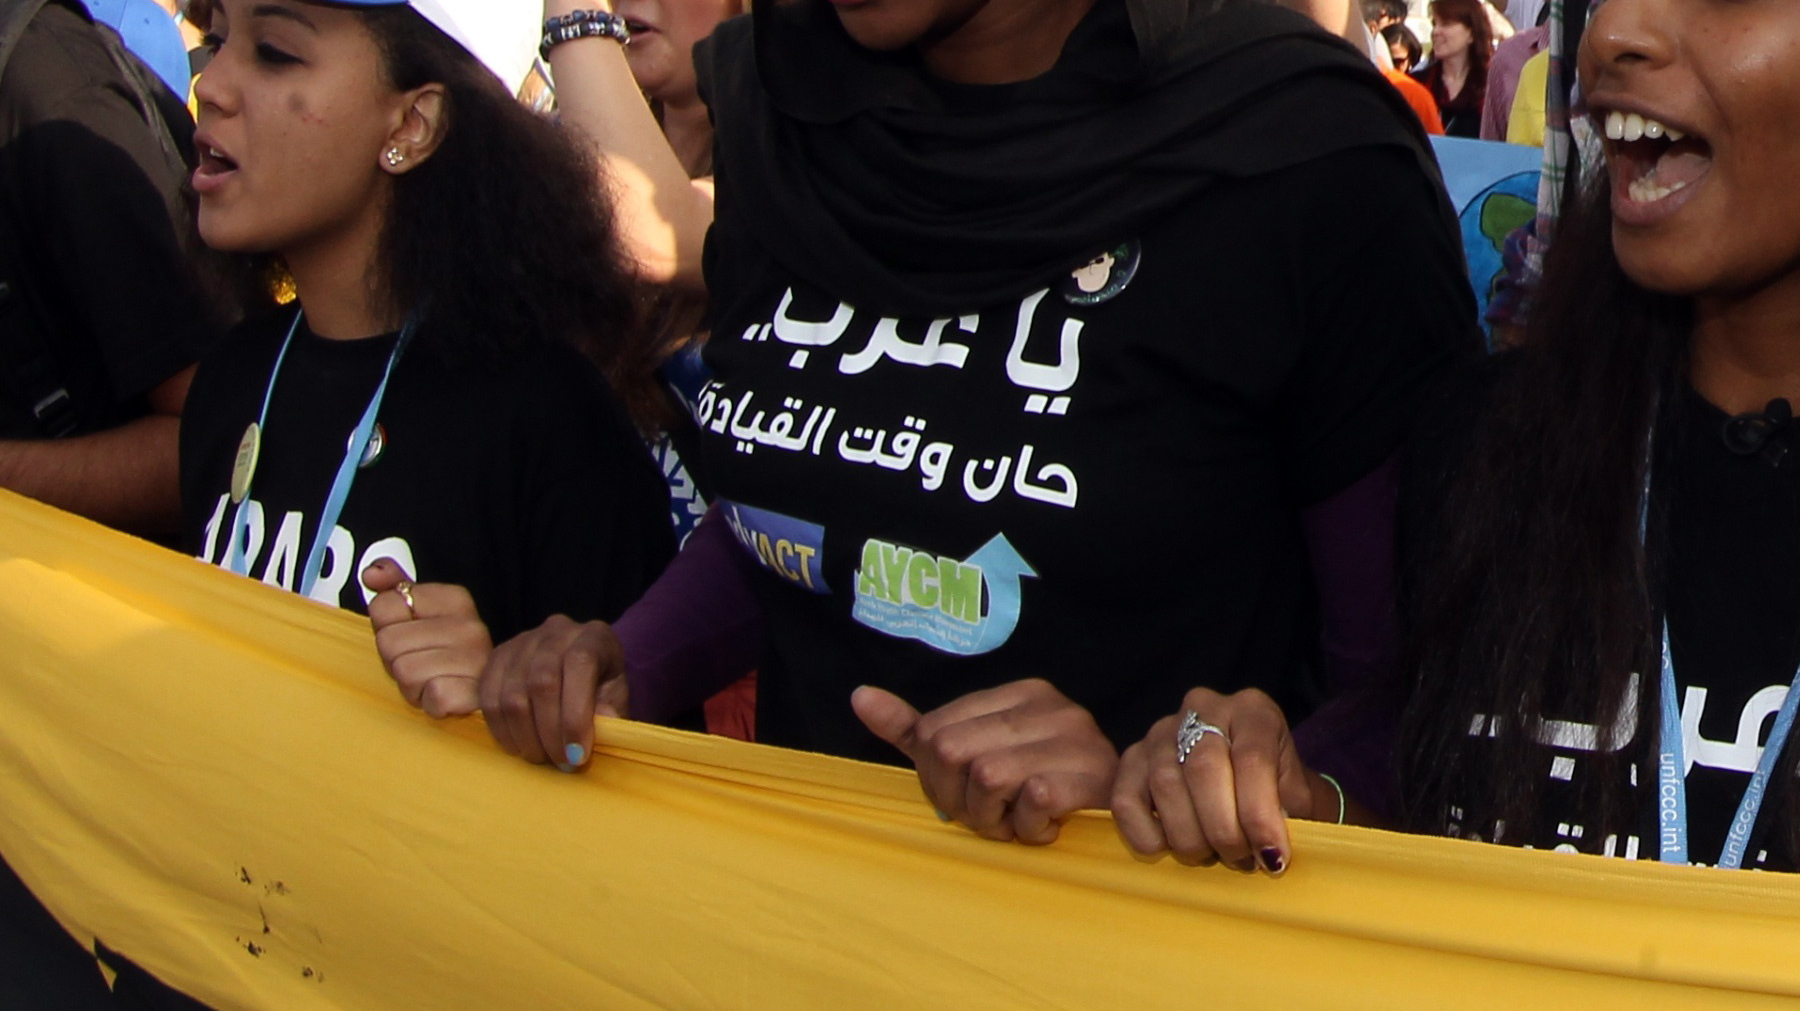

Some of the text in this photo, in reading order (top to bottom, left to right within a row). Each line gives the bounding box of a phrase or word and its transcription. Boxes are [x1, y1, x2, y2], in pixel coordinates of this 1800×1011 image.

[1005, 288, 1086, 416] يا
[837, 415, 955, 492] وقت
[962, 444, 1079, 510] حان
[857, 538, 982, 626] AYCM
[1659, 752, 1682, 853] unfccc.int
[1723, 769, 1768, 869] unfccc.int
